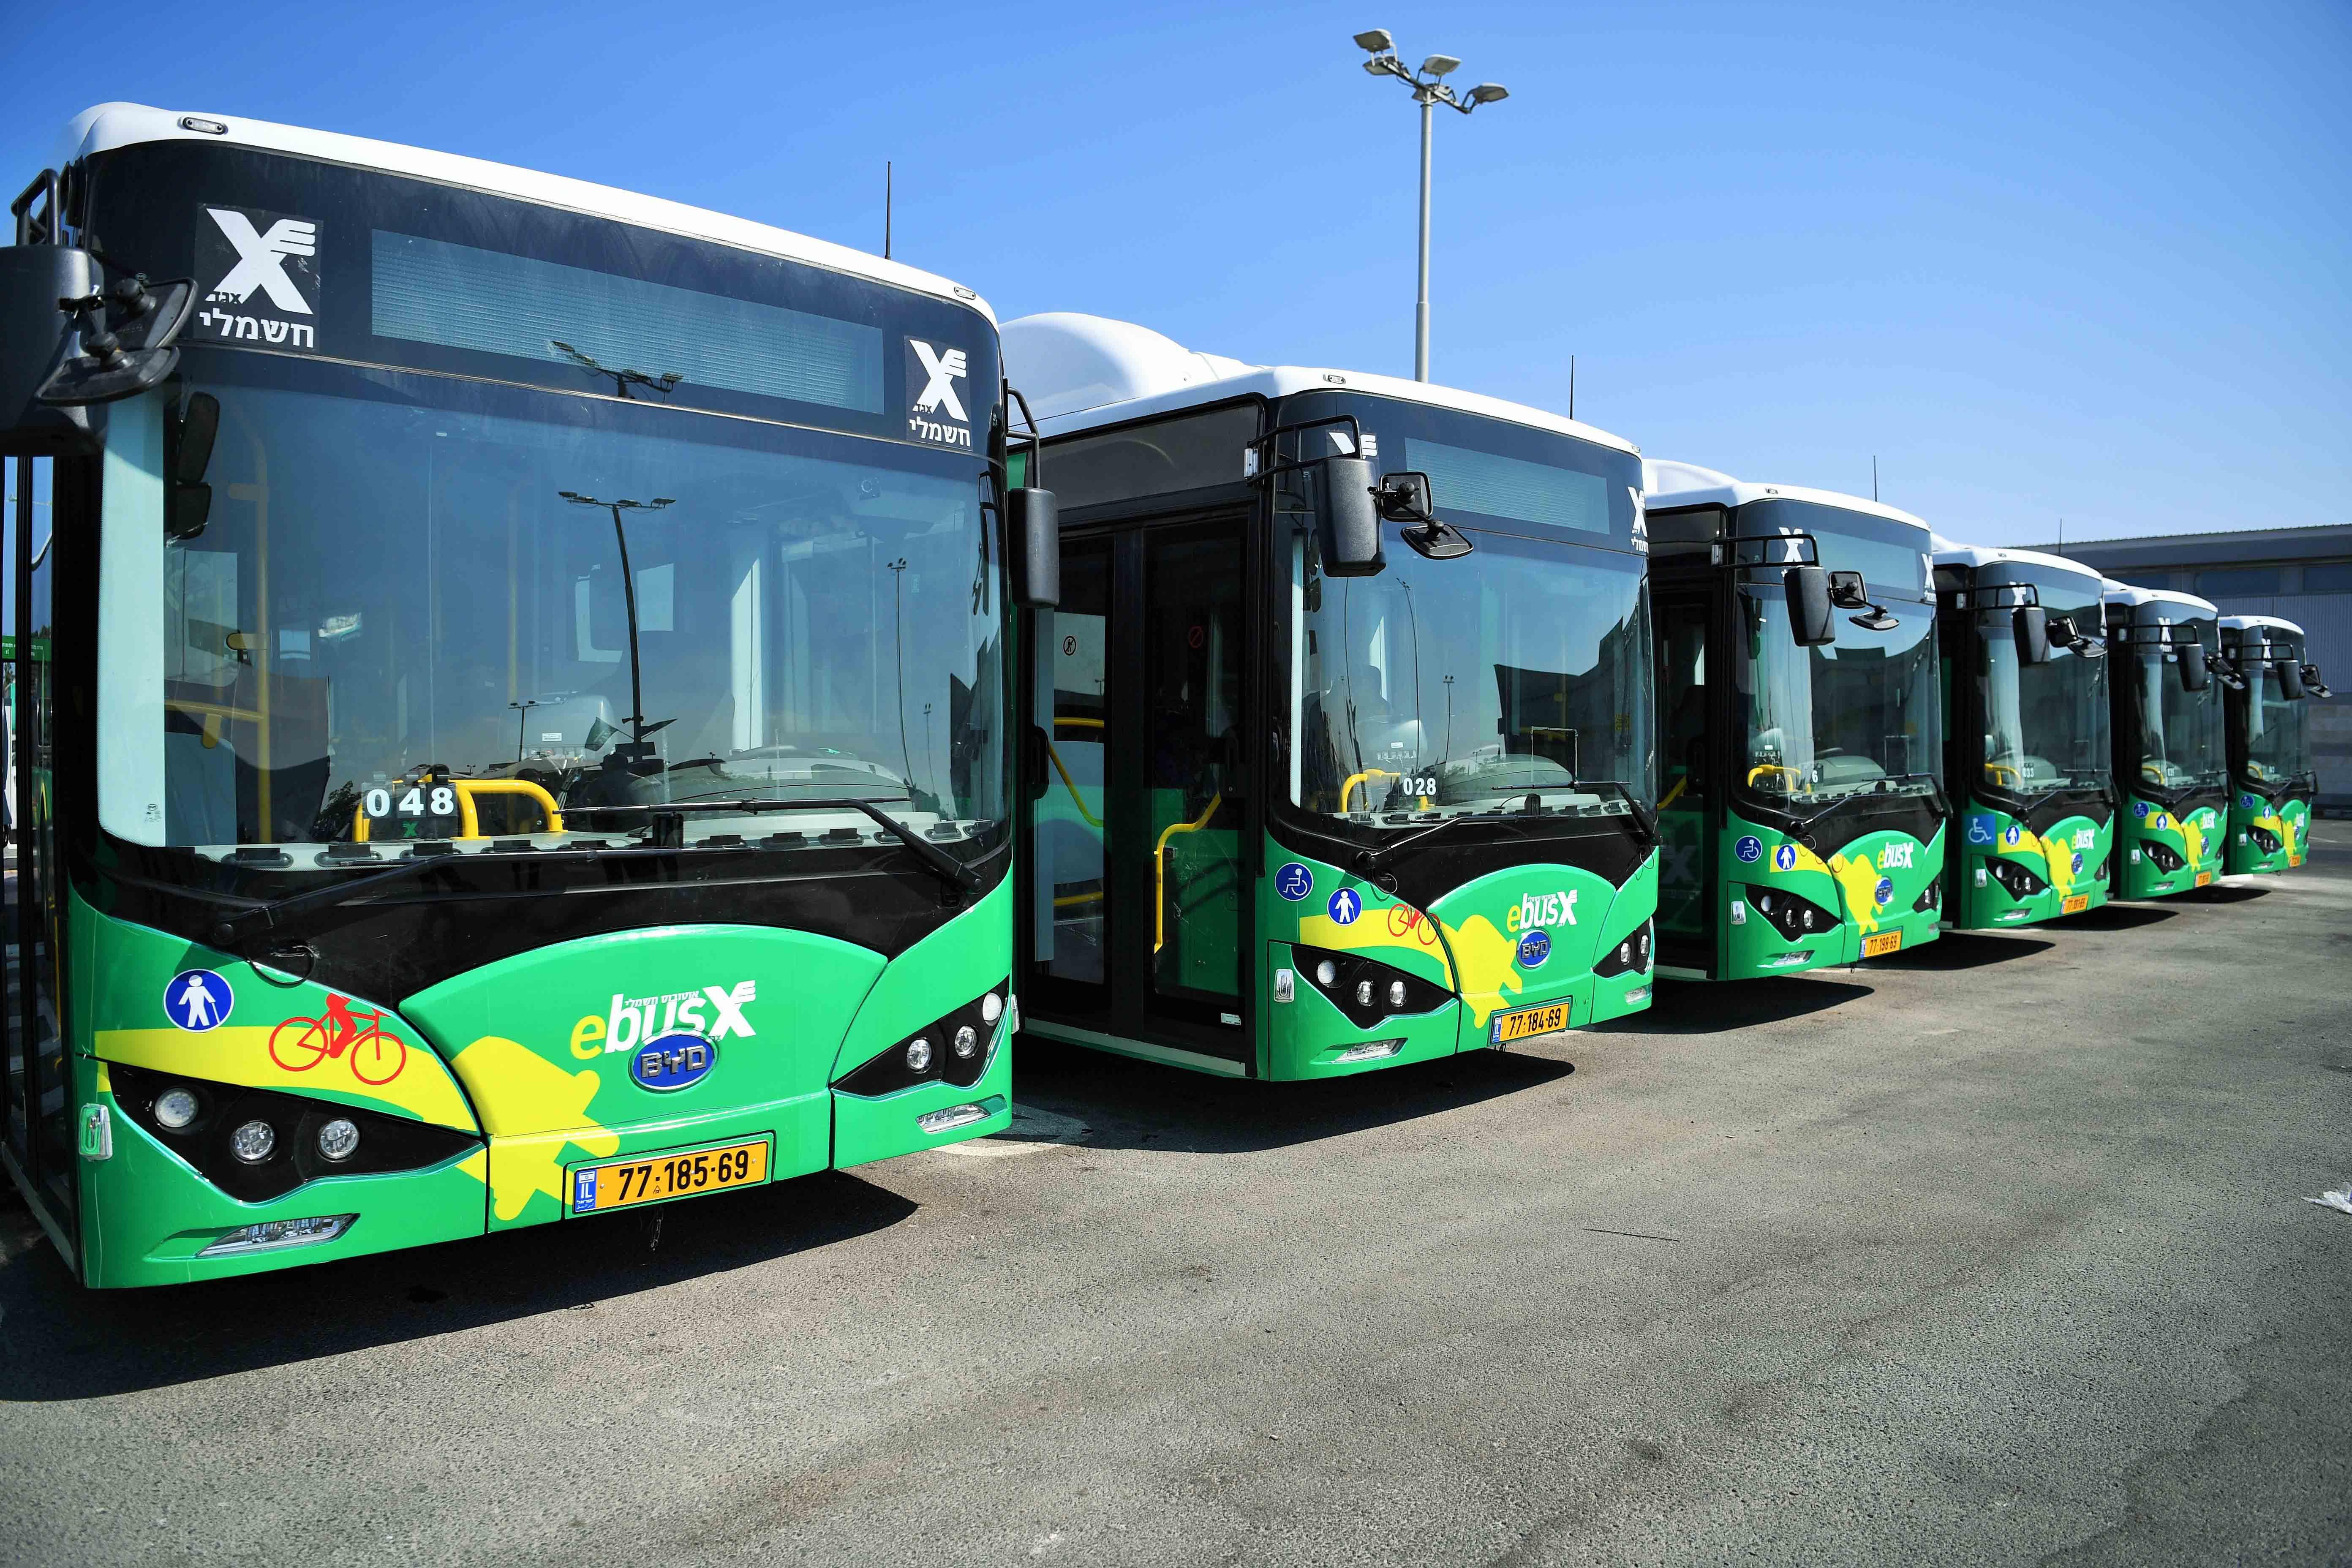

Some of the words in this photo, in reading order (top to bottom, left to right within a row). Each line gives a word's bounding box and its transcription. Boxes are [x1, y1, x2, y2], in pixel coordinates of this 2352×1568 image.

[199, 308, 313, 348] חשמלי
[909, 416, 970, 447] חשמלי
[1403, 778, 1436, 795] 028
[366, 787, 454, 817] 048
[1522, 940, 1548, 959] BYD
[641, 1045, 707, 1078] BYD
[581, 1183, 592, 1199] IL
